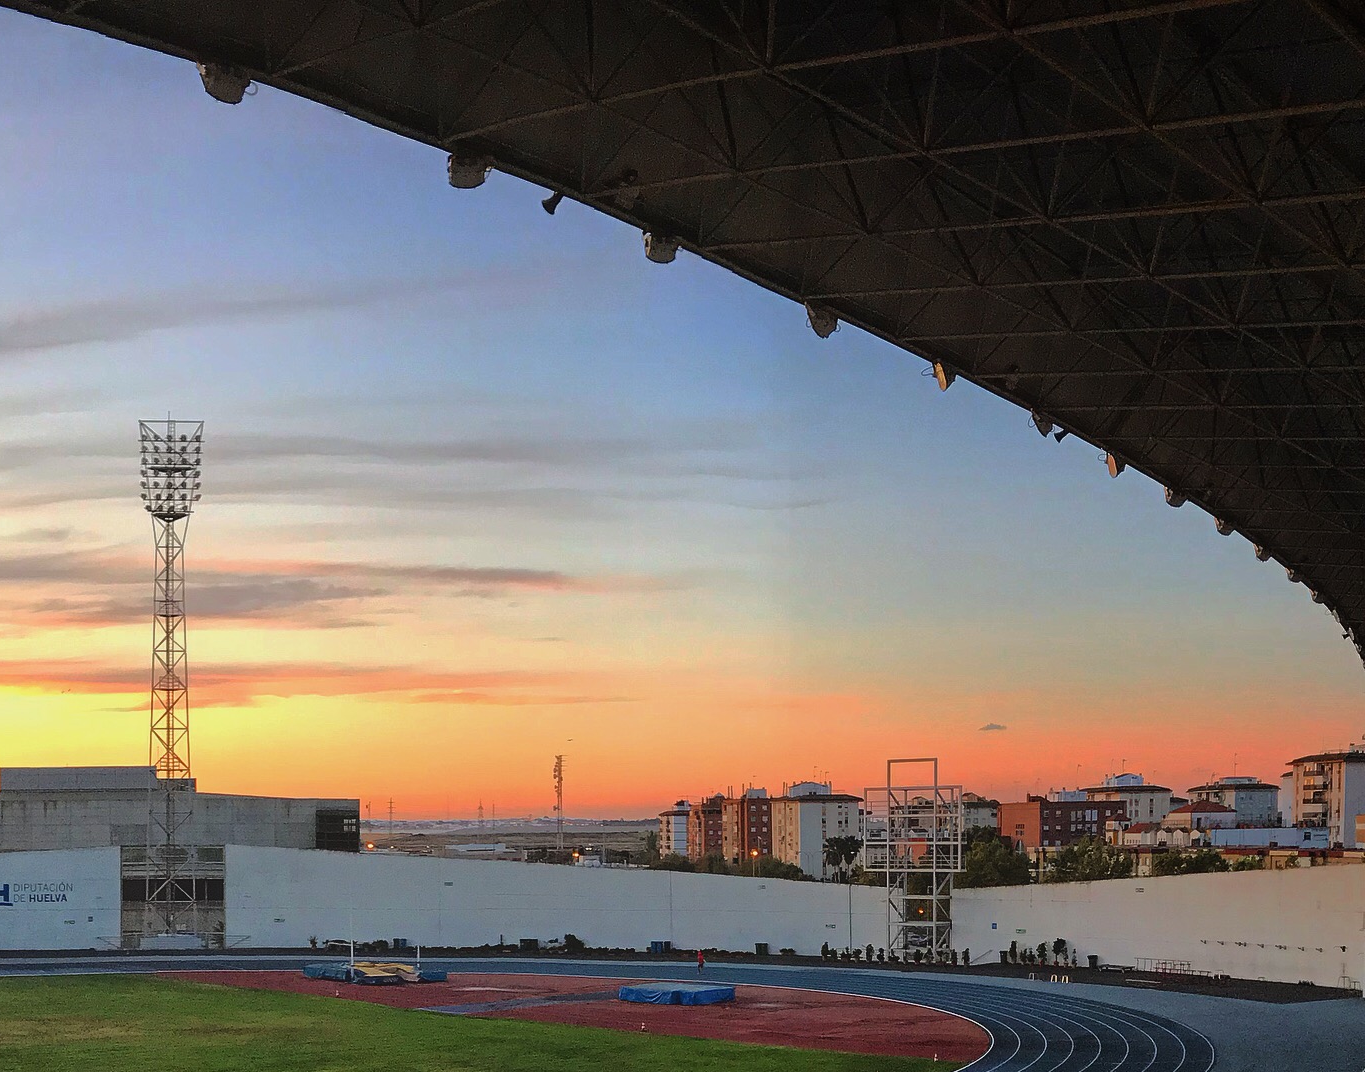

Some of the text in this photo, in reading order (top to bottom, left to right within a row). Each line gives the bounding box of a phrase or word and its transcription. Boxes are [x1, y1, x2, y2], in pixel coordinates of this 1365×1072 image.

[13, 883, 73, 892] DIPUTACIÓN
[13, 894, 67, 902] DE HUELVA
